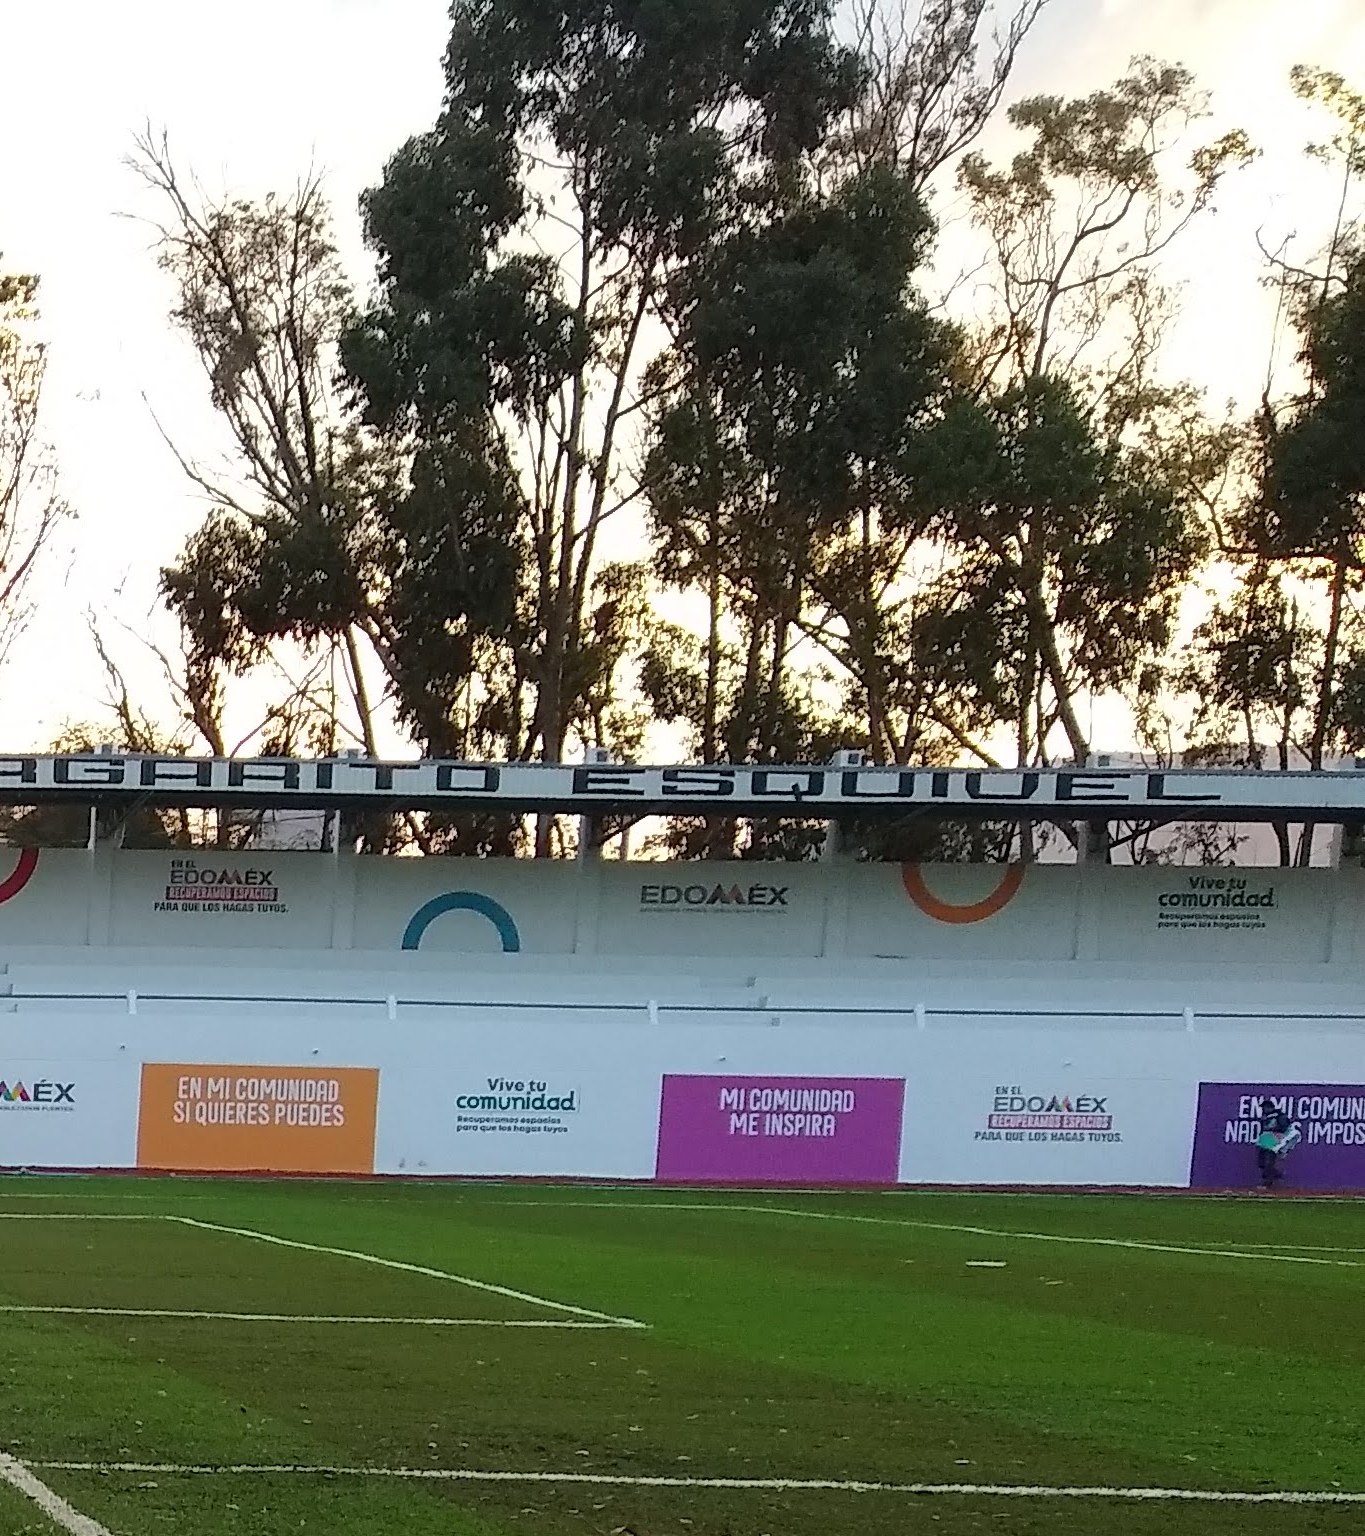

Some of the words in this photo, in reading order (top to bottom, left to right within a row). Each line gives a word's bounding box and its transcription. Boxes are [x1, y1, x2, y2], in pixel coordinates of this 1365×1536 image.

[571, 767, 1222, 802] ESQUIVEL
[171, 860, 183, 868] EN
[171, 868, 274, 885] EDOMÉX
[1188, 876, 1226, 889] Vive
[1229, 878, 1247, 889] tu
[169, 887, 231, 899] RECUPERAMOS
[234, 888, 275, 900] ESPACIOS
[640, 883, 789, 906] EDOMÉX
[1158, 887, 1275, 907] comunidad
[154, 902, 179, 912] PARA
[181, 903, 199, 912] QUE
[202, 903, 220, 912] LOS
[222, 903, 254, 912] HAGAS
[177, 1076, 202, 1100] EN
[207, 1077, 230, 1101] MI
[235, 1078, 340, 1102] COMUNIDAD
[488, 1077, 525, 1091] Vive
[528, 1080, 547, 1091] tu
[995, 1086, 1008, 1095] EN
[1011, 1086, 1022, 1095] EL
[456, 1091, 576, 1111] comunidad
[719, 1088, 746, 1111] MI
[749, 1088, 855, 1113] COMUNIDAD
[993, 1094, 1108, 1113] EDOMÉX
[1238, 1095, 1264, 1119] EN
[173, 1101, 190, 1124] SI
[195, 1102, 270, 1126] QUIERES
[274, 1104, 345, 1127] PUEDES
[457, 1115, 519, 1124] Recuperamos
[991, 1115, 1061, 1128] RECUPERAMOS
[1063, 1116, 1109, 1128] ESPACIOS
[513, 1125, 541, 1134] hagas
[729, 1112, 760, 1136] ME
[765, 1113, 836, 1137] INSPIRA
[1225, 1120, 1262, 1143] NAD
[974, 1131, 1002, 1141] PARA
[1005, 1132, 1025, 1141] QUE
[1028, 1132, 1048, 1141] LOS
[1051, 1132, 1085, 1142] HAGAS
